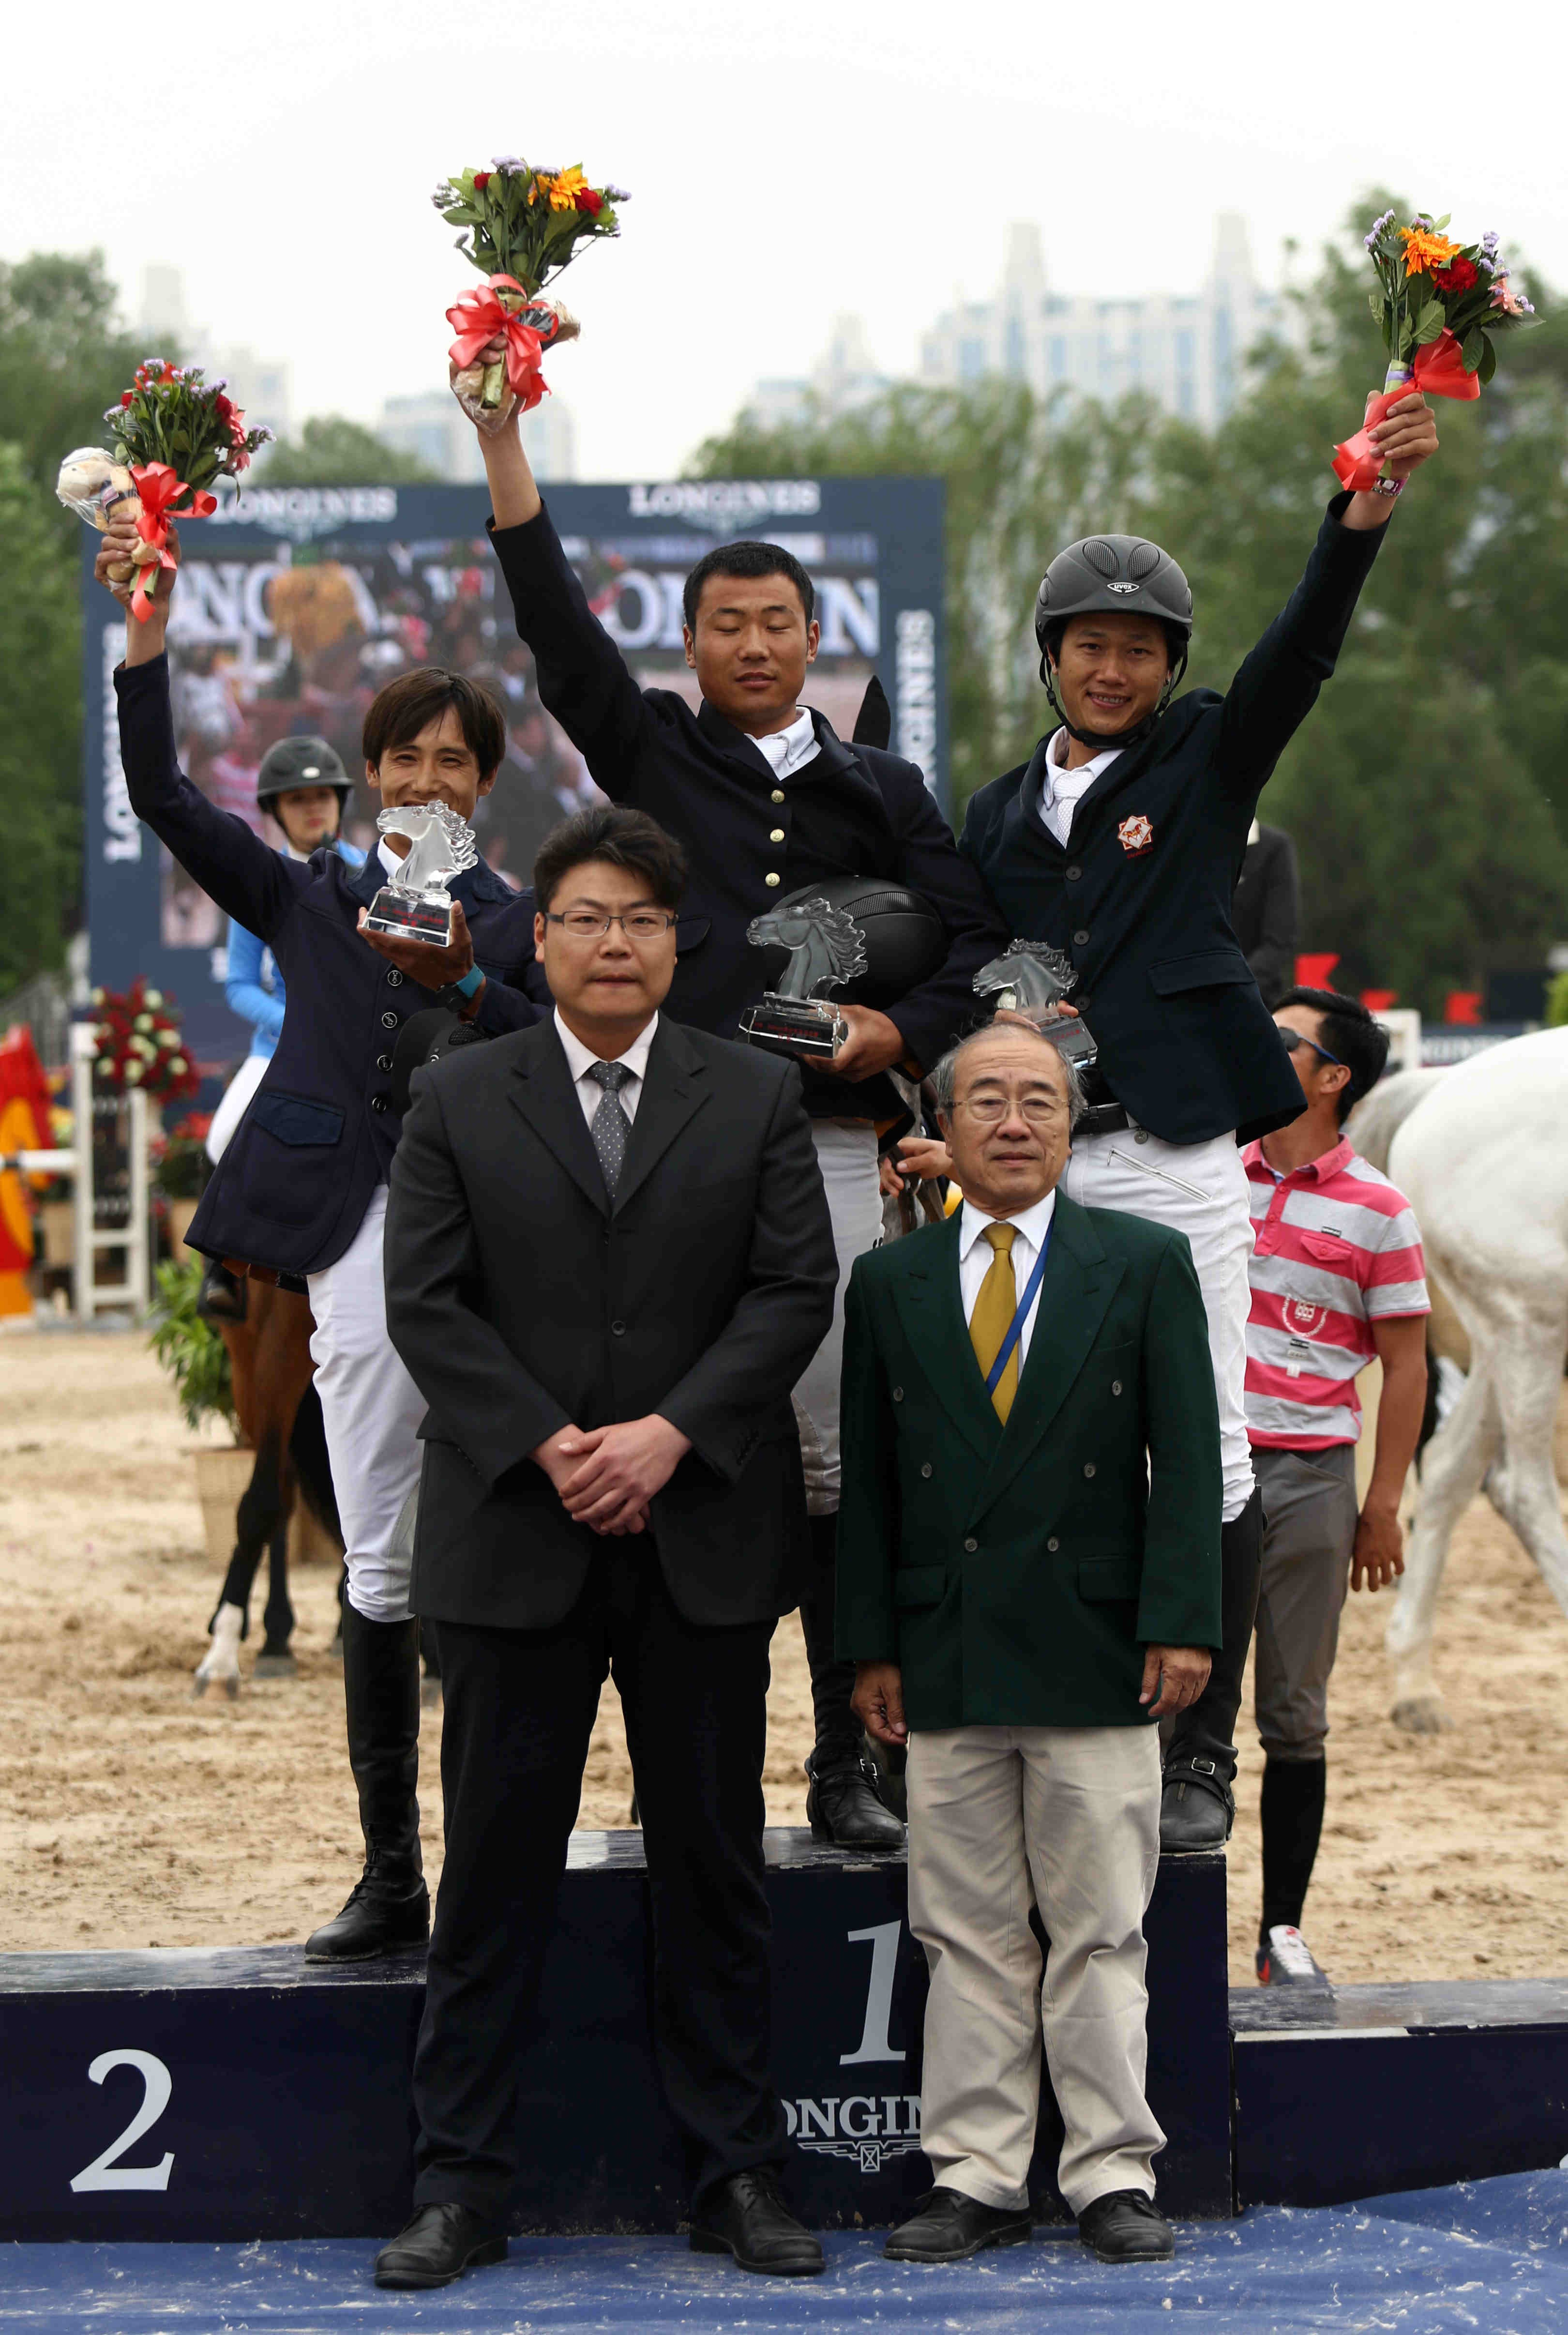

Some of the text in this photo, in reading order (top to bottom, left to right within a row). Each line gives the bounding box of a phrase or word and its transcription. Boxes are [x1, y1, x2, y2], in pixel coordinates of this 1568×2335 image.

[628, 480, 821, 516] LONGINES
[840, 1920, 906, 2065] 1
[70, 2048, 175, 2192] 2
